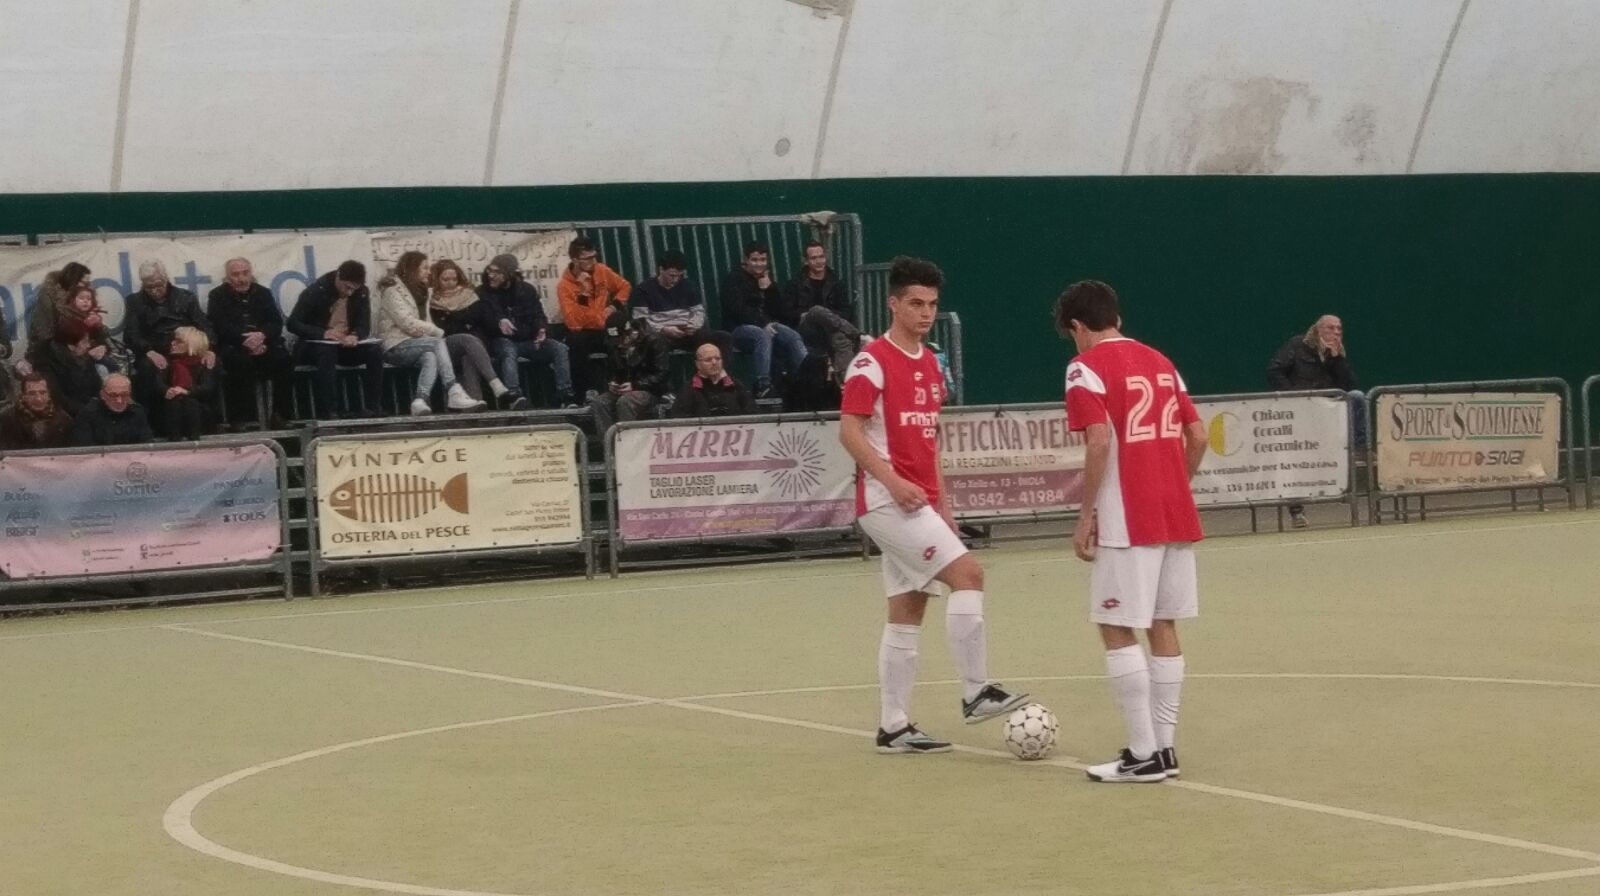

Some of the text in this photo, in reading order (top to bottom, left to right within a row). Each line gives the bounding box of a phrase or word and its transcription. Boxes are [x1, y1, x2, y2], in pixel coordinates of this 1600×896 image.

[1125, 373, 1184, 443] 22
[1252, 409, 1295, 422] Chiara
[1391, 401, 1446, 442] SPORT
[1451, 400, 1545, 441] SCOMMESSE
[650, 427, 757, 460] MARRI
[1253, 439, 1320, 454] Ceramiche
[328, 448, 467, 468] VINTAGE
[1408, 450, 1473, 468] PUNTO
[650, 474, 716, 489] TAGLIO LASER
[650, 483, 760, 499] LAVORAZIONE LAMIERA
[968, 492, 1006, 507] 0542
[1019, 489, 1065, 504] 41984
[331, 529, 397, 544] OSTERIA
[425, 525, 471, 539] PESCE
